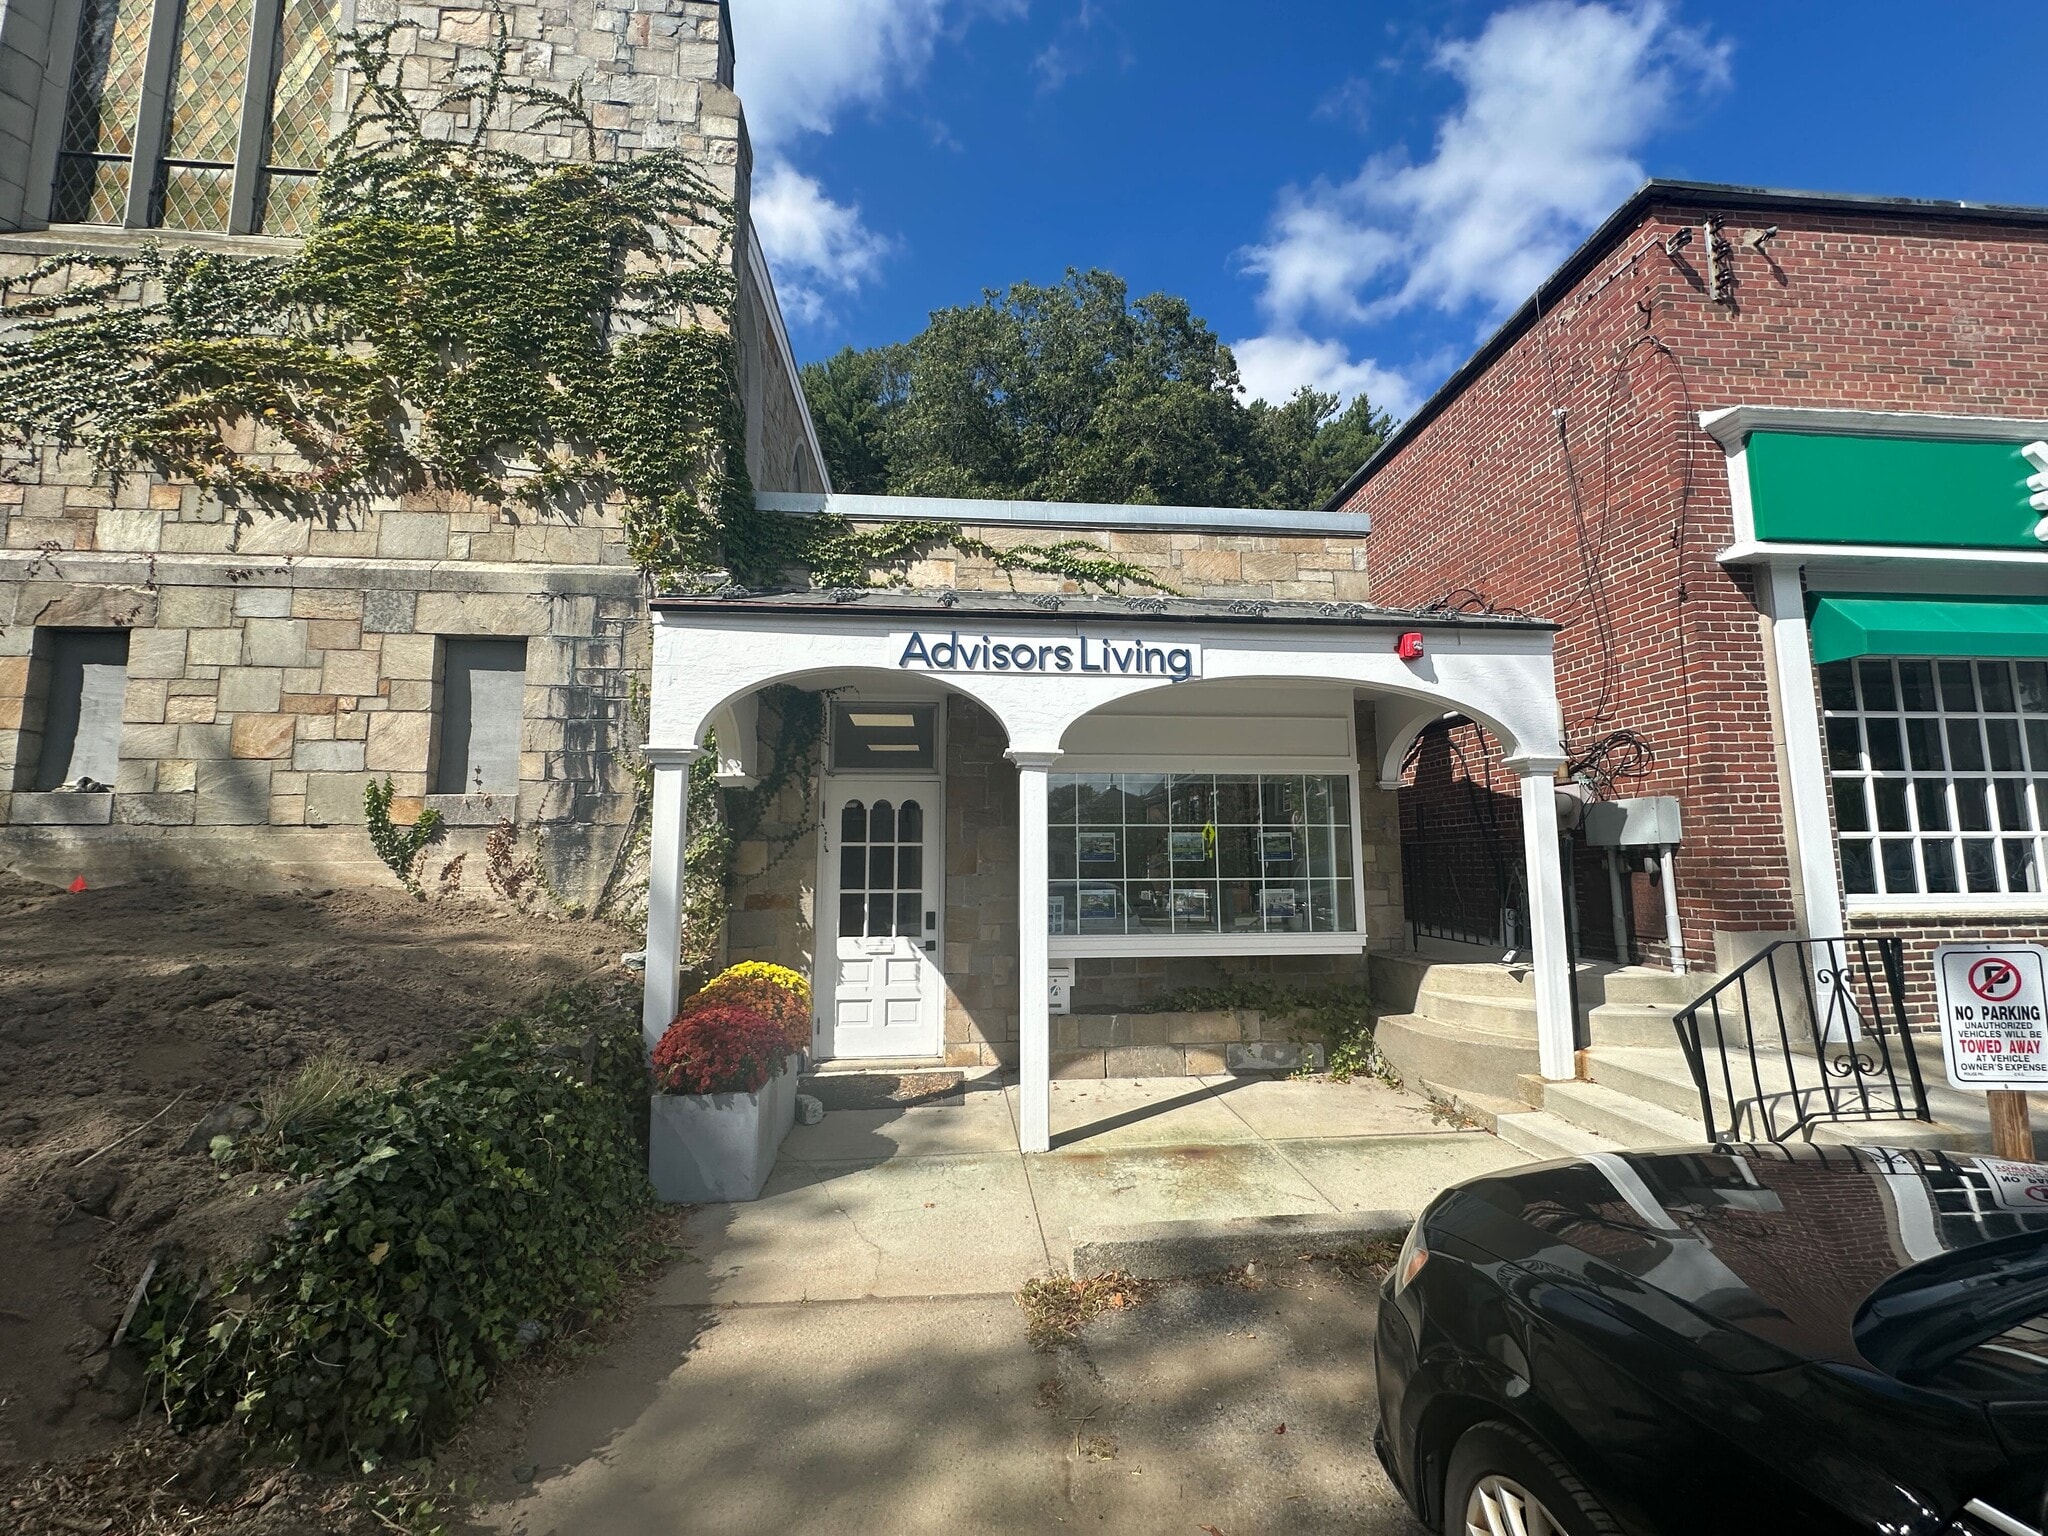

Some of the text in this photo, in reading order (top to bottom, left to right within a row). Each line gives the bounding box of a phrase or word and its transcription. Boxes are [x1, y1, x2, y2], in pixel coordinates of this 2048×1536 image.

[1955, 1005, 2041, 1020] NO PARKING
[1965, 1022, 2033, 1030] UNAUTHORIZED
[1958, 1030, 2042, 1039] VEHICLES WILL BE
[1959, 1039, 2041, 1054] TOWED AWAY
[1961, 1063, 2048, 1072] OWNER'S EXPENSE
